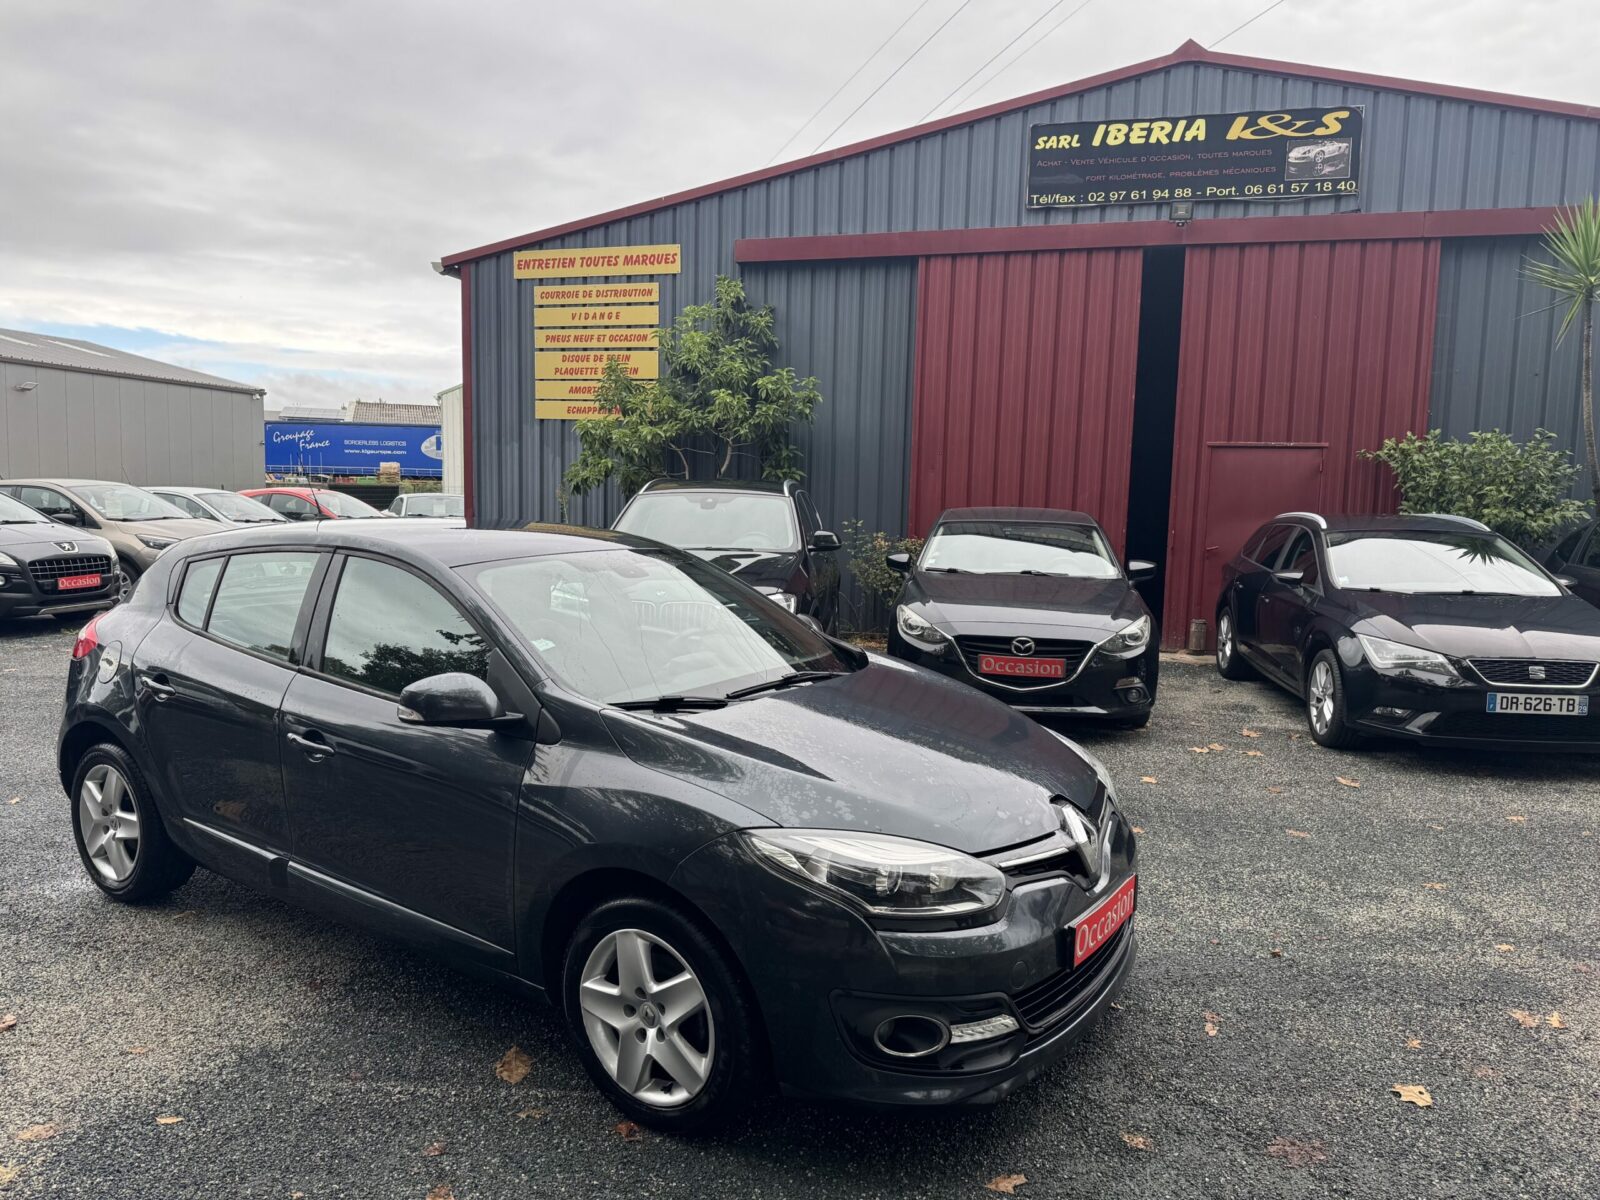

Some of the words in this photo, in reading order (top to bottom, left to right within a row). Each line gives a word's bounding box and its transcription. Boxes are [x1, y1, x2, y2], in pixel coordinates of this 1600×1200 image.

[1034, 134, 1081, 150] SARL
[1091, 118, 1206, 147] IBERIA
[1232, 149, 1273, 157] MARQUES
[1031, 193, 1076, 204] Tél/fax
[1088, 192, 1105, 202] 02
[1109, 191, 1126, 202] 97
[1130, 190, 1147, 200] 61
[1152, 189, 1170, 200] 94
[1174, 188, 1192, 198] 88
[1206, 186, 1239, 197] Port.
[1244, 185, 1263, 195] 06
[1267, 184, 1285, 194] 61
[1290, 183, 1309, 193] 57
[1315, 182, 1333, 192] 18
[1337, 181, 1356, 191] 40
[516, 256, 577, 271] ENTRETIEN
[580, 255, 620, 268] TOUTES
[623, 253, 678, 267] MARQUES
[540, 290, 580, 300] COURROIE
[582, 290, 593, 299] DE
[595, 288, 653, 298] DISTRIBUTION
[545, 334, 571, 343] PNEUS
[573, 334, 595, 343] NEUF
[597, 334, 607, 343] ET
[608, 333, 648, 343] OCCASION
[561, 354, 591, 363] DISQUE
[593, 354, 604, 363] DE
[554, 367, 599, 376] PLAQUETTE
[273, 430, 315, 443] Groupage
[300, 440, 330, 451] France
[59, 577, 100, 588] Occasion
[982, 657, 1062, 675] Occasion
[1500, 696, 1576, 712] DR-626-TB
[1578, 705, 1588, 713] 29
[1077, 888, 1134, 958] Occasion
